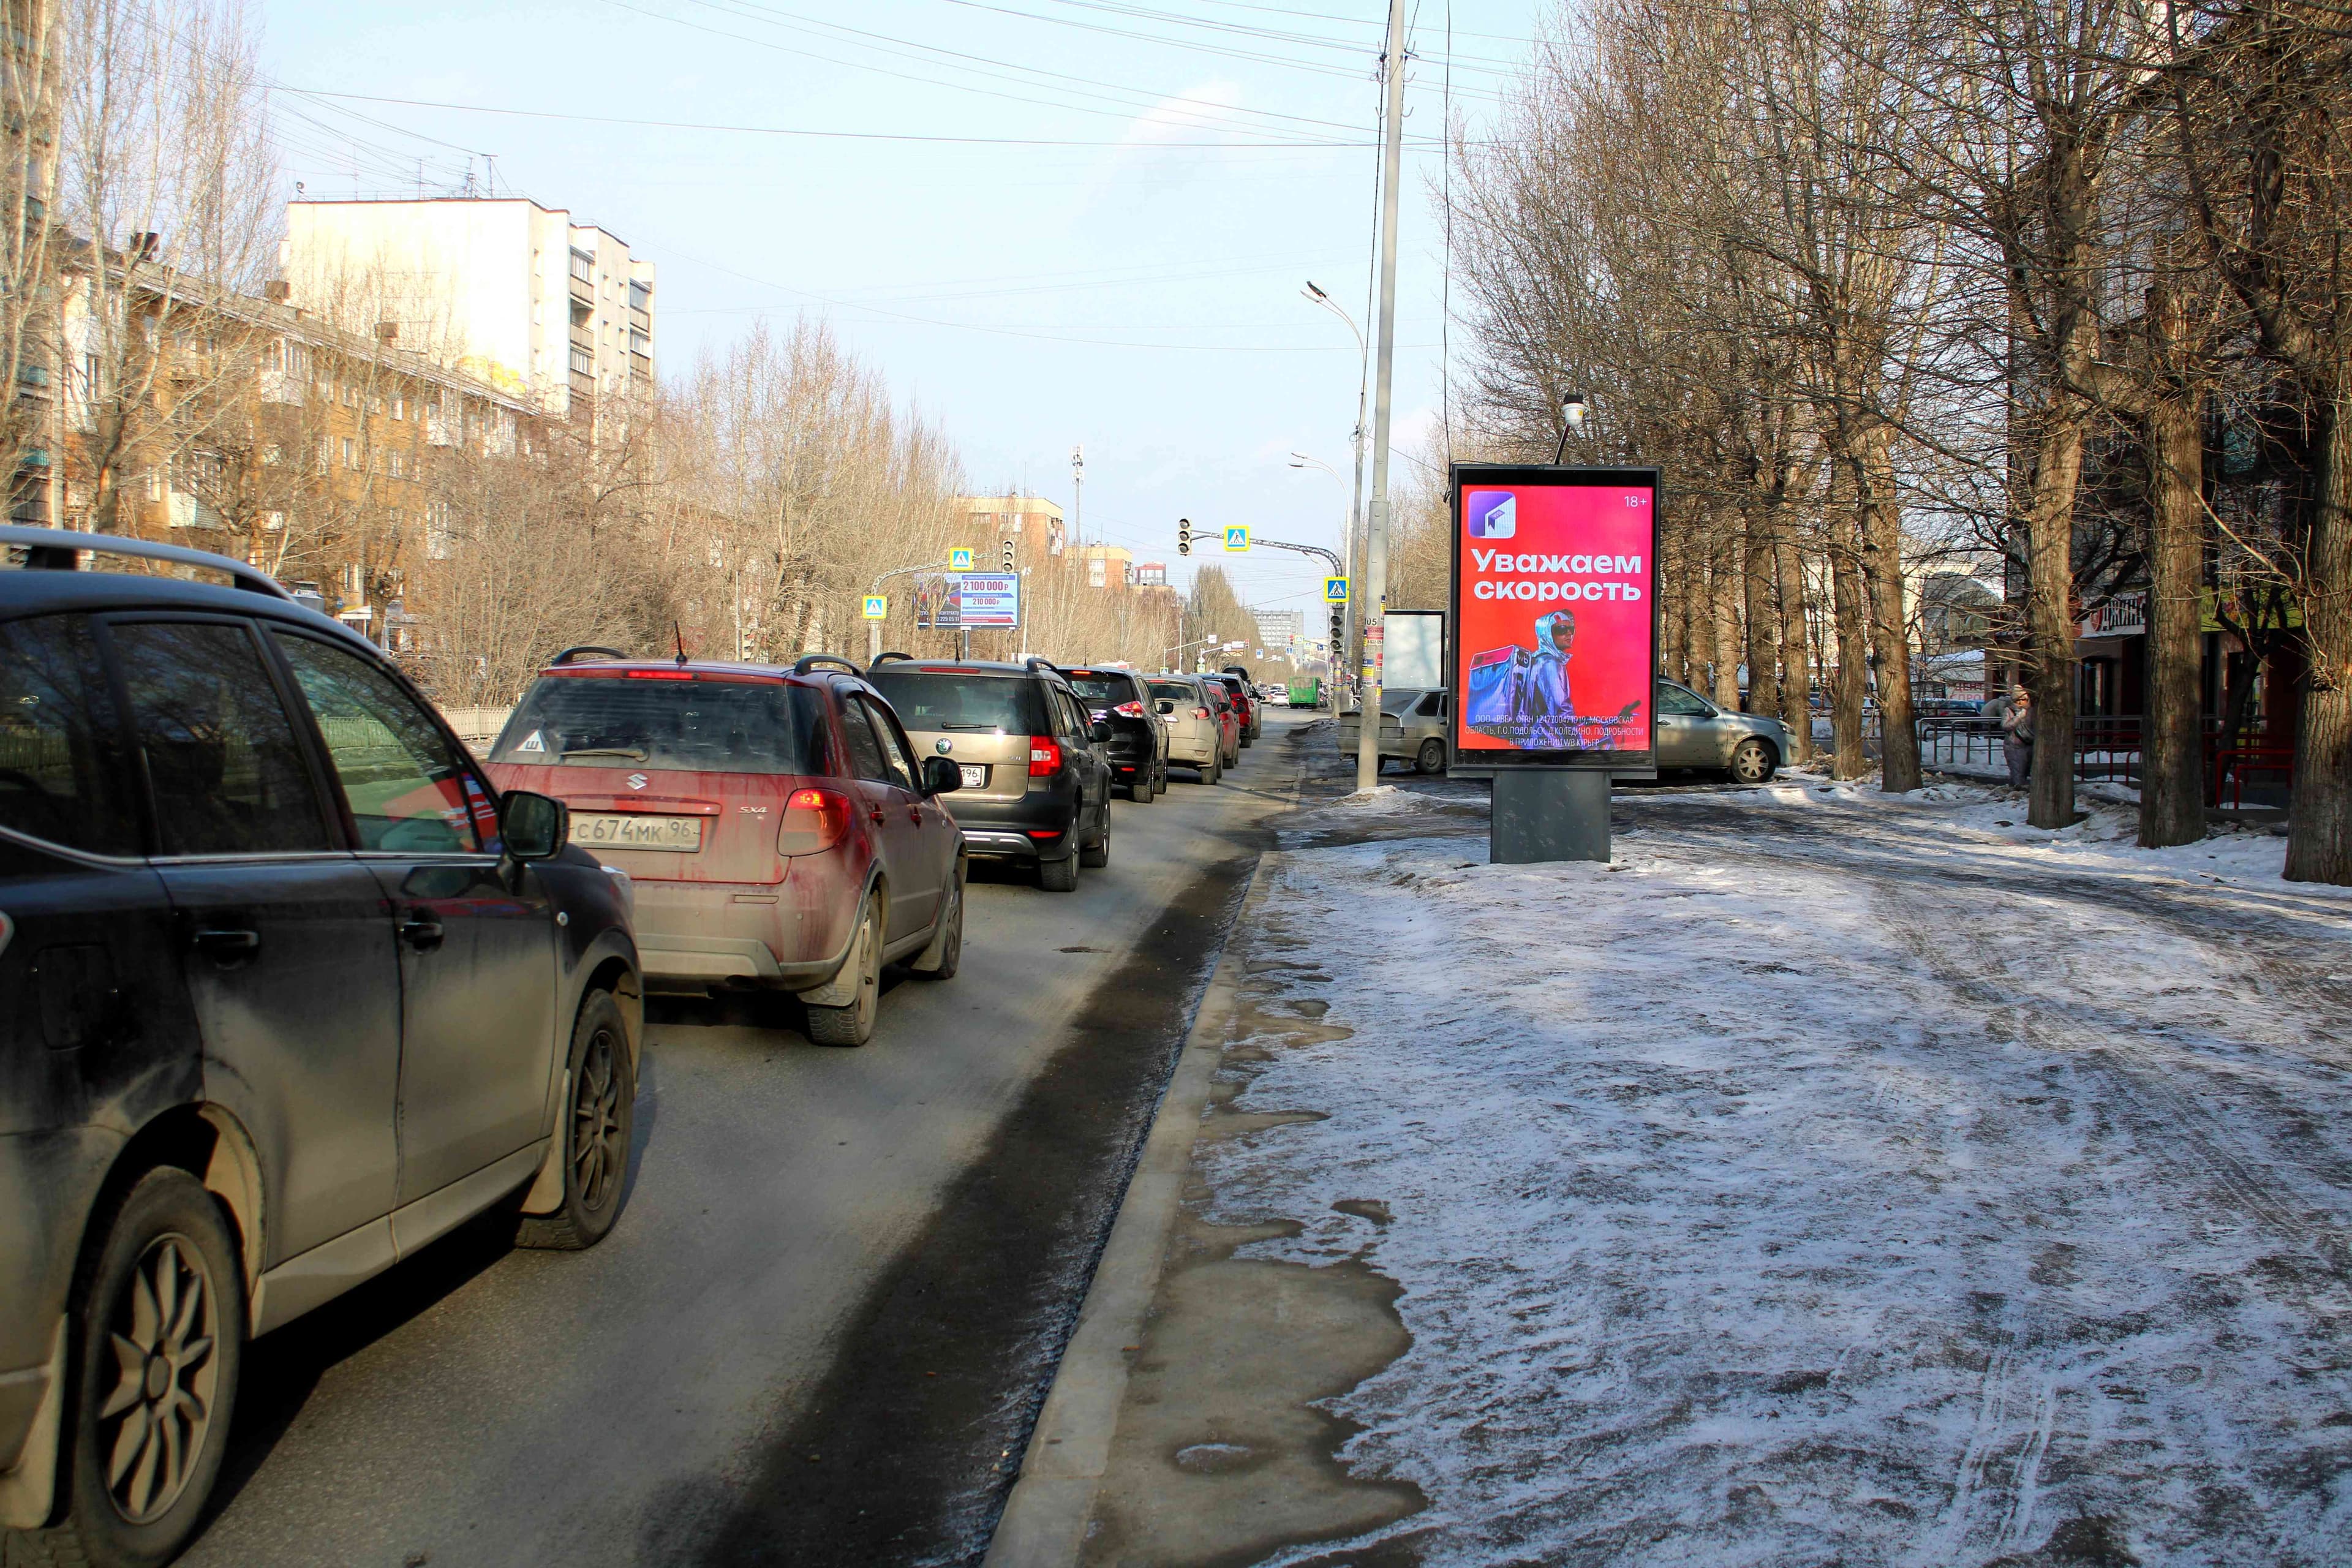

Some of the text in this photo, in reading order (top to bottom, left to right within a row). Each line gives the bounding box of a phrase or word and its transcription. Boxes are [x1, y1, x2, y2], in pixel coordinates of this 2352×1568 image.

[1624, 496, 1648, 508] 18+
[1471, 549, 1642, 574] Уважаем
[1474, 581, 1642, 601] скорость
[1475, 714, 1491, 723] ООО
[1594, 727, 1644, 736] ПОДРОБНОСТИ
[525, 741, 540, 750] Ш
[1515, 738, 1562, 747] ПРИЛОЖЕНИИ
[960, 769, 978, 778] 196
[671, 821, 691, 838] 96
